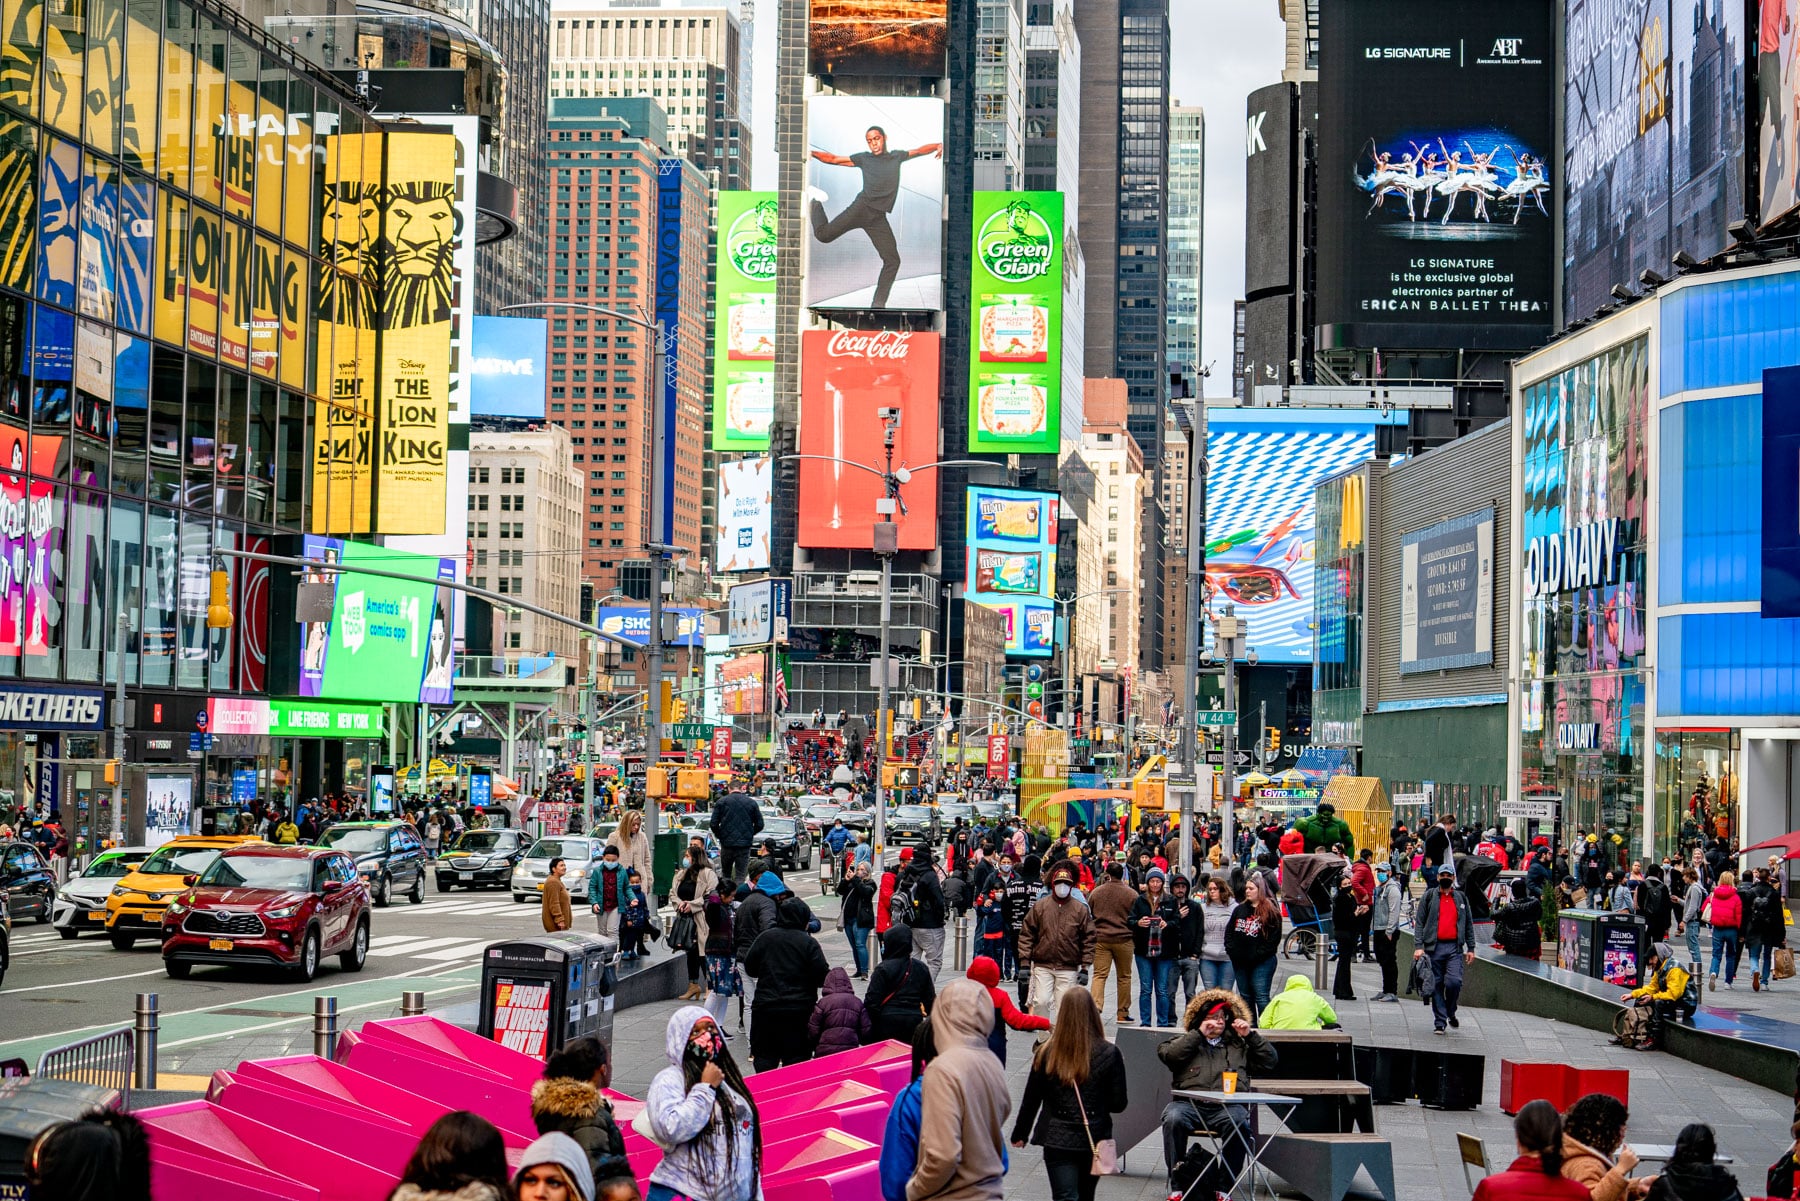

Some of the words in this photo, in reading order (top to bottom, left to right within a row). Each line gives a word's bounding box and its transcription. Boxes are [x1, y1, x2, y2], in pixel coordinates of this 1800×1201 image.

[1366, 48, 1381, 58] LG
[1384, 48, 1451, 58] SIGNATURE
[1490, 38, 1522, 56] ABT
[659, 176, 681, 312] NOVOTEL
[988, 240, 1048, 257] Green
[995, 258, 1049, 275] Giant
[1410, 259, 1425, 268] LG
[1429, 259, 1494, 268] SIGNATURE
[1391, 273, 1400, 282] is
[1404, 273, 1421, 282] the
[1425, 273, 1475, 282] exclusive
[1480, 273, 1513, 284] global
[1392, 287, 1453, 296] electronics
[1457, 289, 1498, 298] partner
[1502, 287, 1513, 296] of
[1430, 300, 1490, 310] BALLET
[190, 329, 216, 348] ENTRANCE
[222, 341, 231, 354] ON
[394, 378, 430, 395] THE
[388, 399, 436, 428] LION
[383, 431, 443, 465] KING
[1528, 533, 1562, 596] OLD
[1564, 517, 1619, 591] NAVY
[366, 597, 399, 615] America's
[370, 621, 393, 637] comics
[394, 627, 407, 643] app
[0, 692, 102, 723] SKECHERS
[222, 710, 257, 724] COLLECTION
[288, 710, 303, 728] LINE
[304, 711, 330, 728] FRIENDS
[337, 712, 353, 728] NEW
[353, 713, 369, 729] YORK
[1199, 713, 1206, 723] W
[1210, 713, 1224, 723] 44
[674, 725, 684, 737] W
[688, 725, 701, 737] 44
[1559, 723, 1573, 749] OLD
[1573, 723, 1596, 748] NAVY
[716, 730, 729, 755] tkts
[991, 737, 1005, 762] tkts
[508, 985, 550, 1008] FIGHT
[509, 1007, 549, 1031] VIRUS
